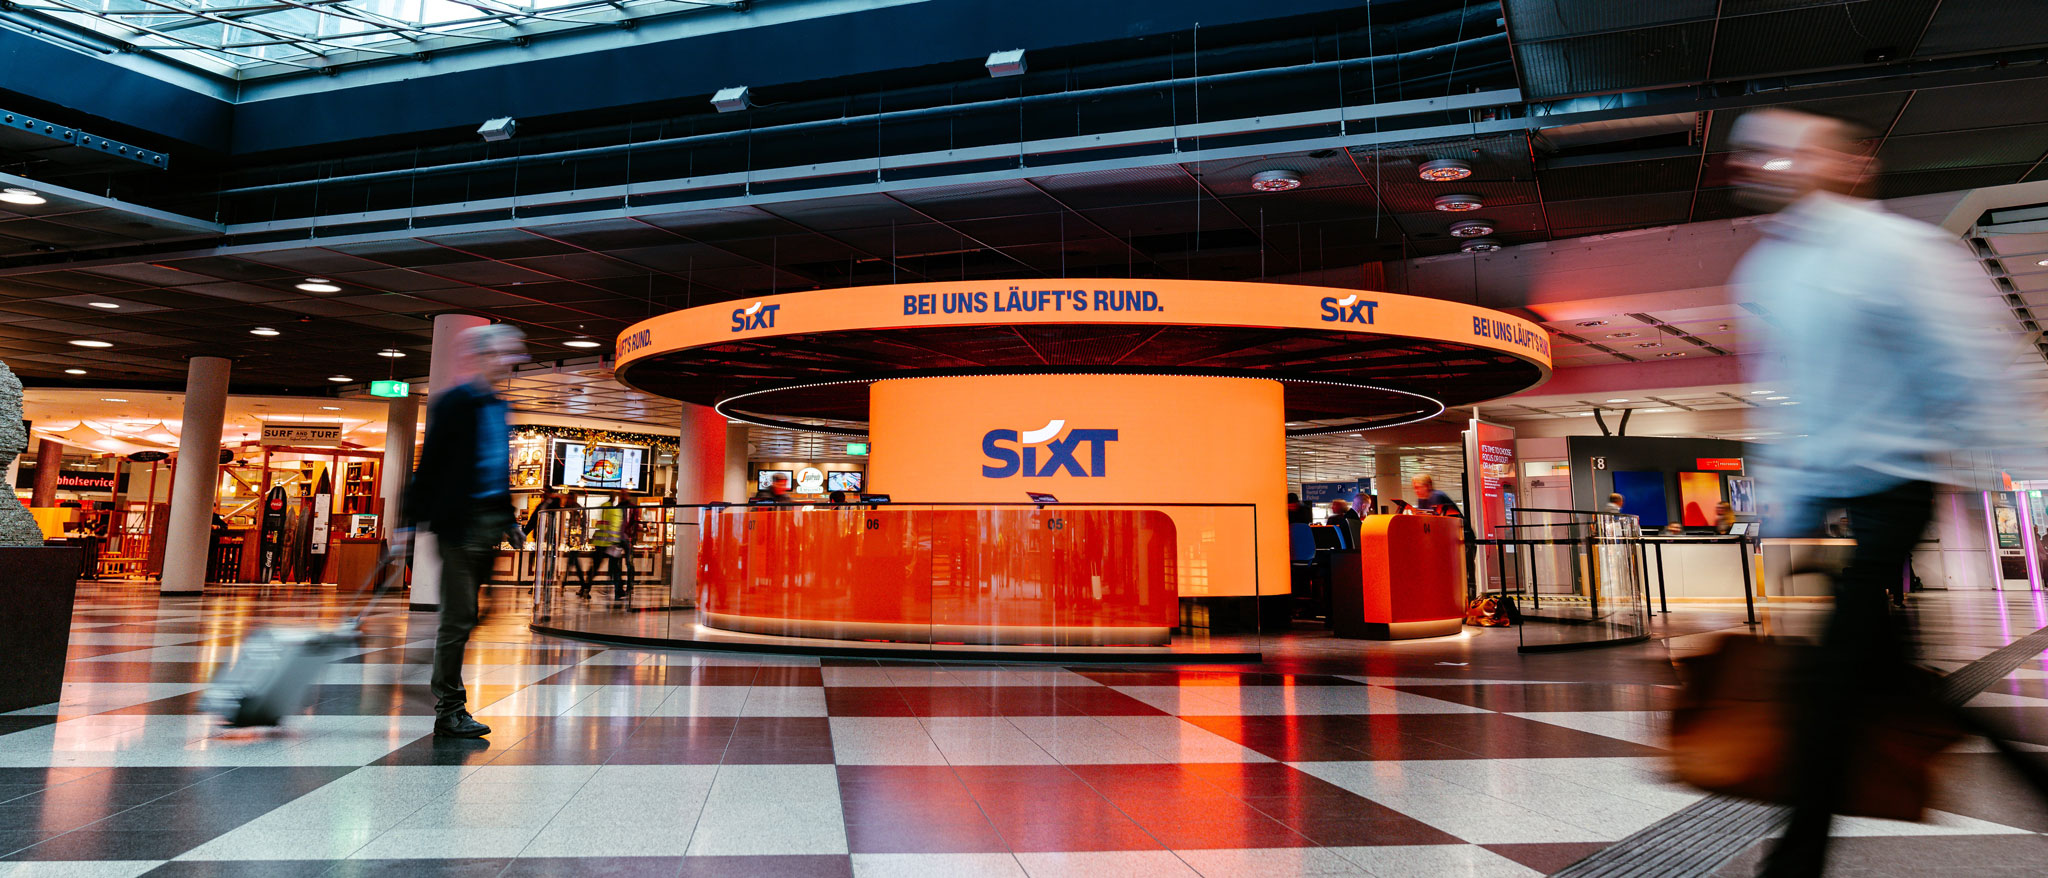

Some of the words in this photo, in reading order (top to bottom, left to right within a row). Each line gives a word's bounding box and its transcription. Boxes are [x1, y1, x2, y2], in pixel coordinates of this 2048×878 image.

[903, 294, 936, 315] BEI
[942, 292, 988, 314] UNS
[994, 286, 1088, 312] LÄUFT'S
[1093, 290, 1164, 312] RUND.
[1321, 294, 1378, 325] SIXT
[731, 301, 780, 332] SIXT
[632, 329, 652, 351] RUND.
[1473, 316, 1491, 338] BEI
[1493, 322, 1512, 343] UNS
[1513, 323, 1539, 352] LÄUFT'S
[982, 419, 1119, 478] SIXT
[1597, 458, 1605, 470] 8
[57, 476, 114, 488] bholservice
[866, 519, 879, 530] 06
[1047, 518, 1063, 530] 05
